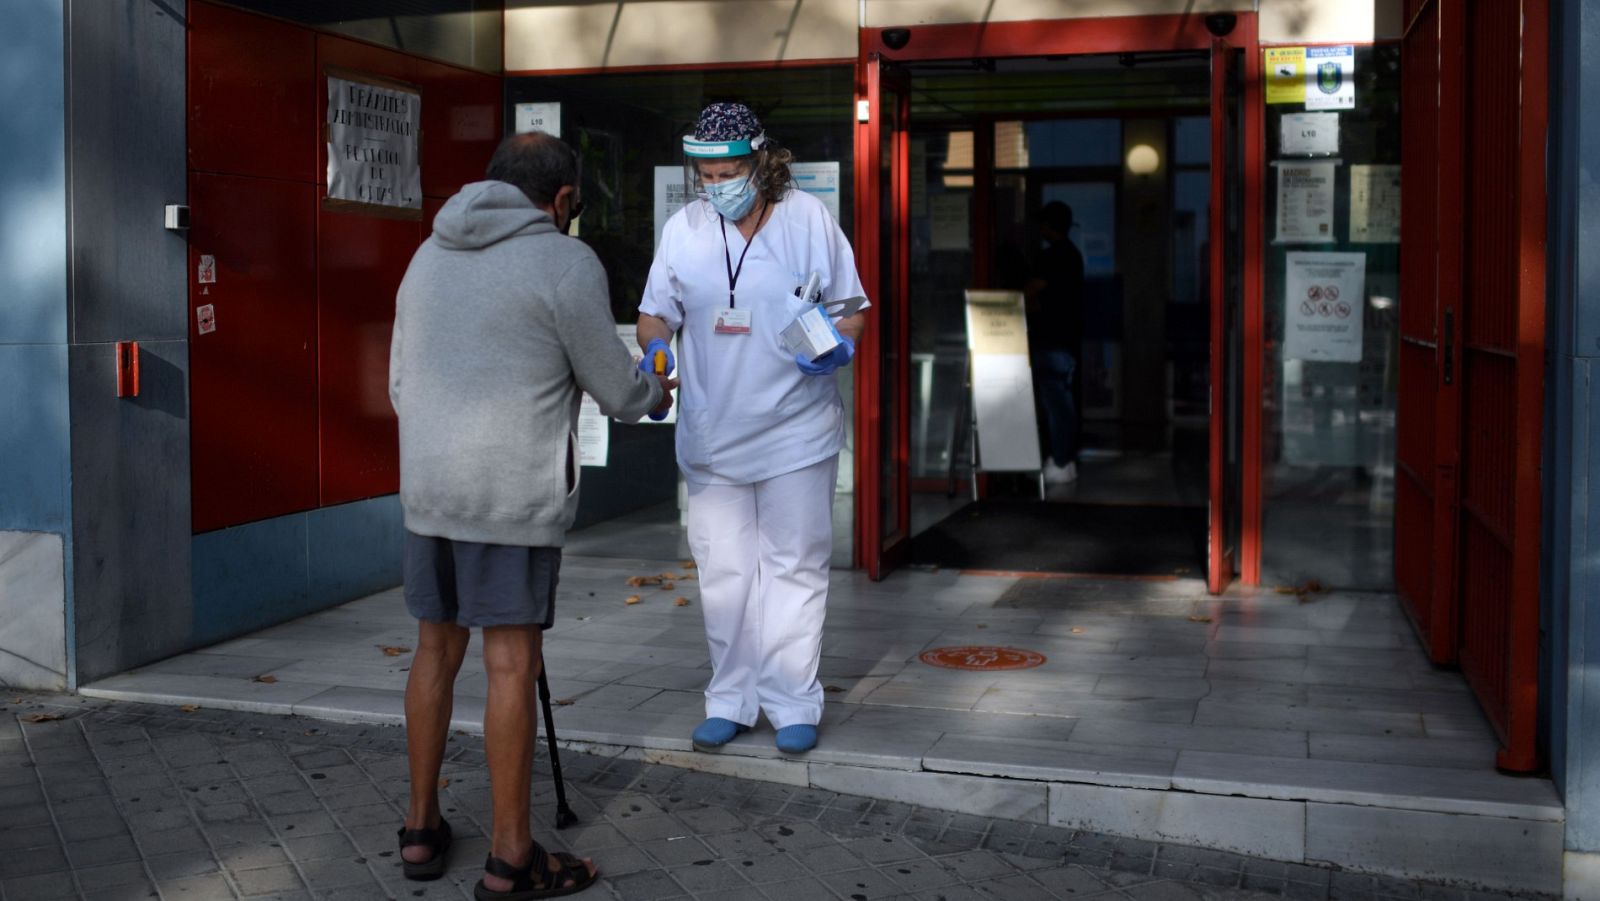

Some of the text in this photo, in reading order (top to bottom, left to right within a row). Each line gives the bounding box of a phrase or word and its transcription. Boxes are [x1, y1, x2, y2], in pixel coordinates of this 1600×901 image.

[531, 118, 543, 126] L10
[1301, 130, 1317, 138] L10
[370, 166, 384, 180] DE
[359, 184, 393, 201] CITAS
